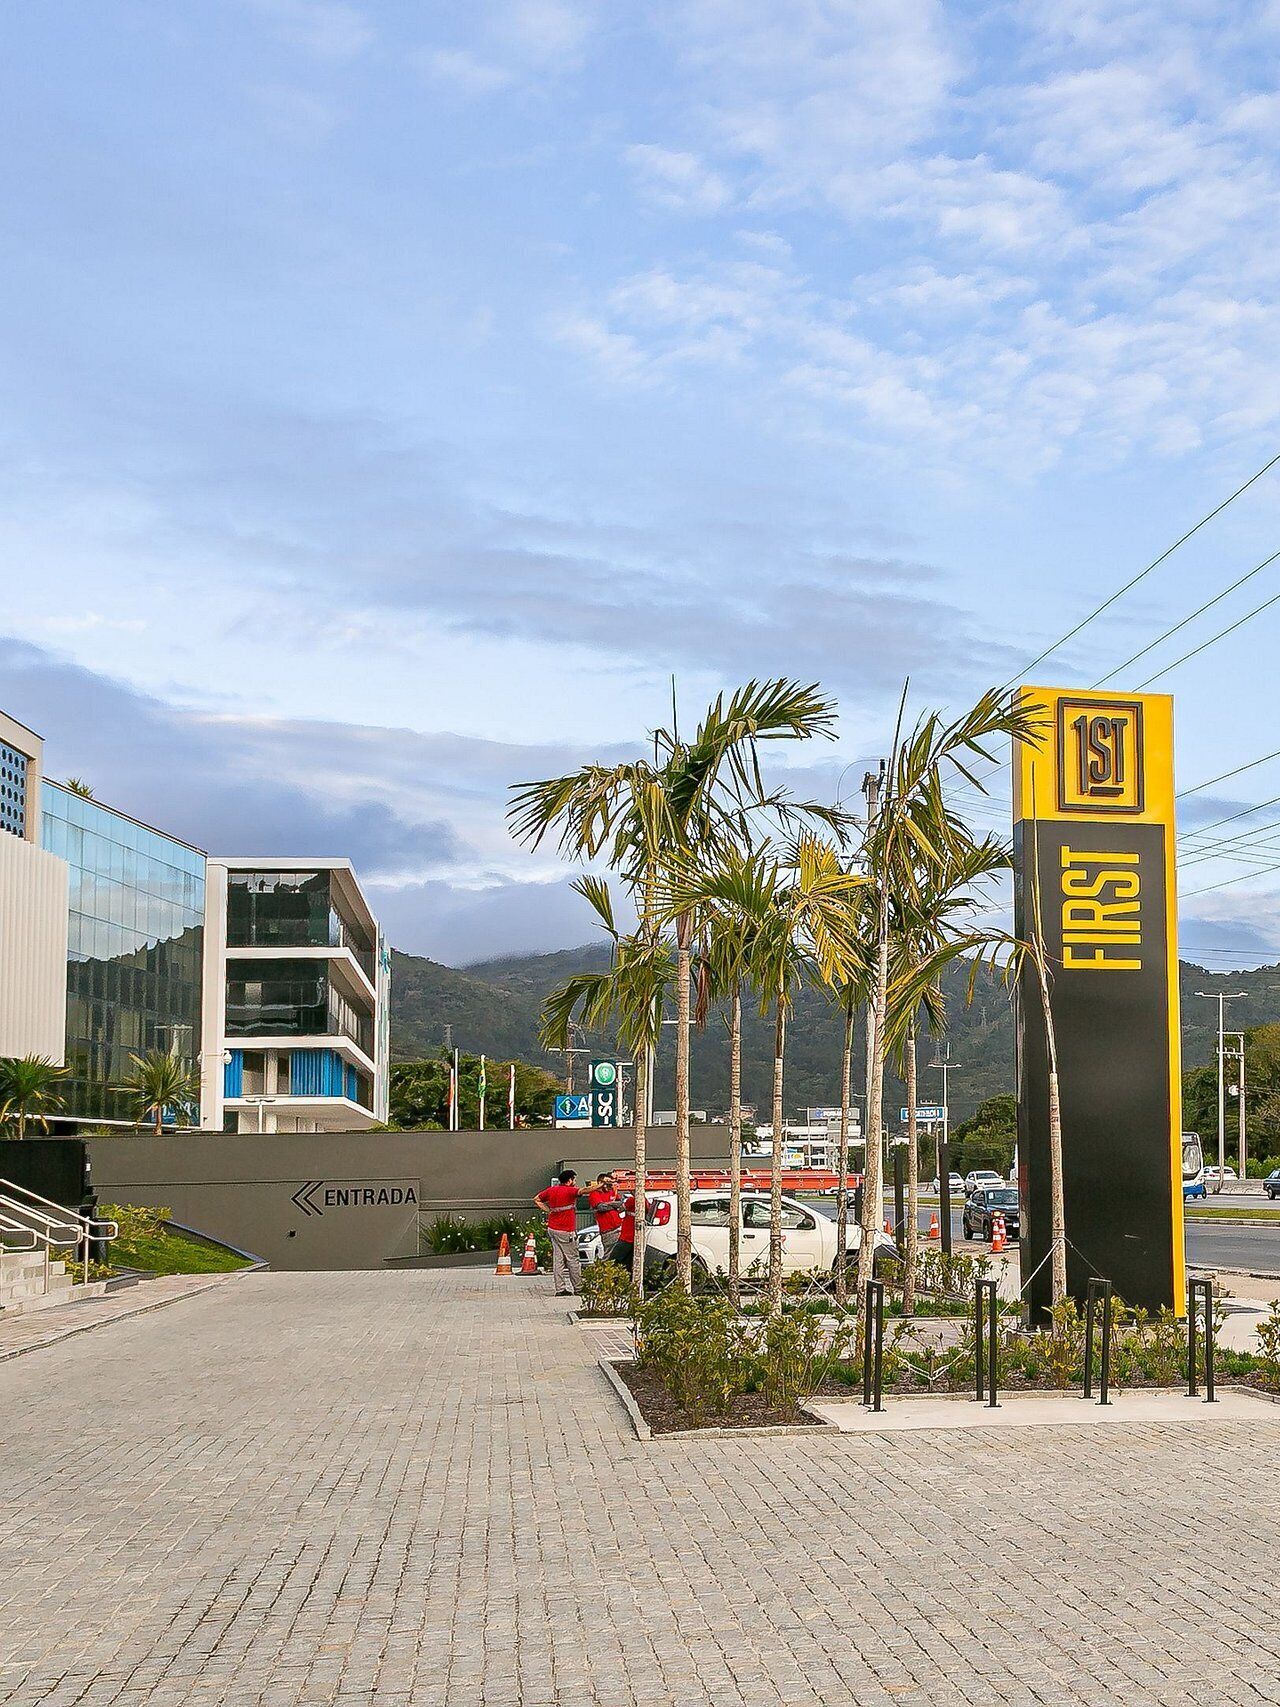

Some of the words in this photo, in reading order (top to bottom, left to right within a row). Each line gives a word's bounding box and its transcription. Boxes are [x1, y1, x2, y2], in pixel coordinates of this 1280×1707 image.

[1074, 715, 1128, 795] 1ST
[1061, 845, 1142, 970] FIRST
[324, 1187, 418, 1207] ENTRADA
